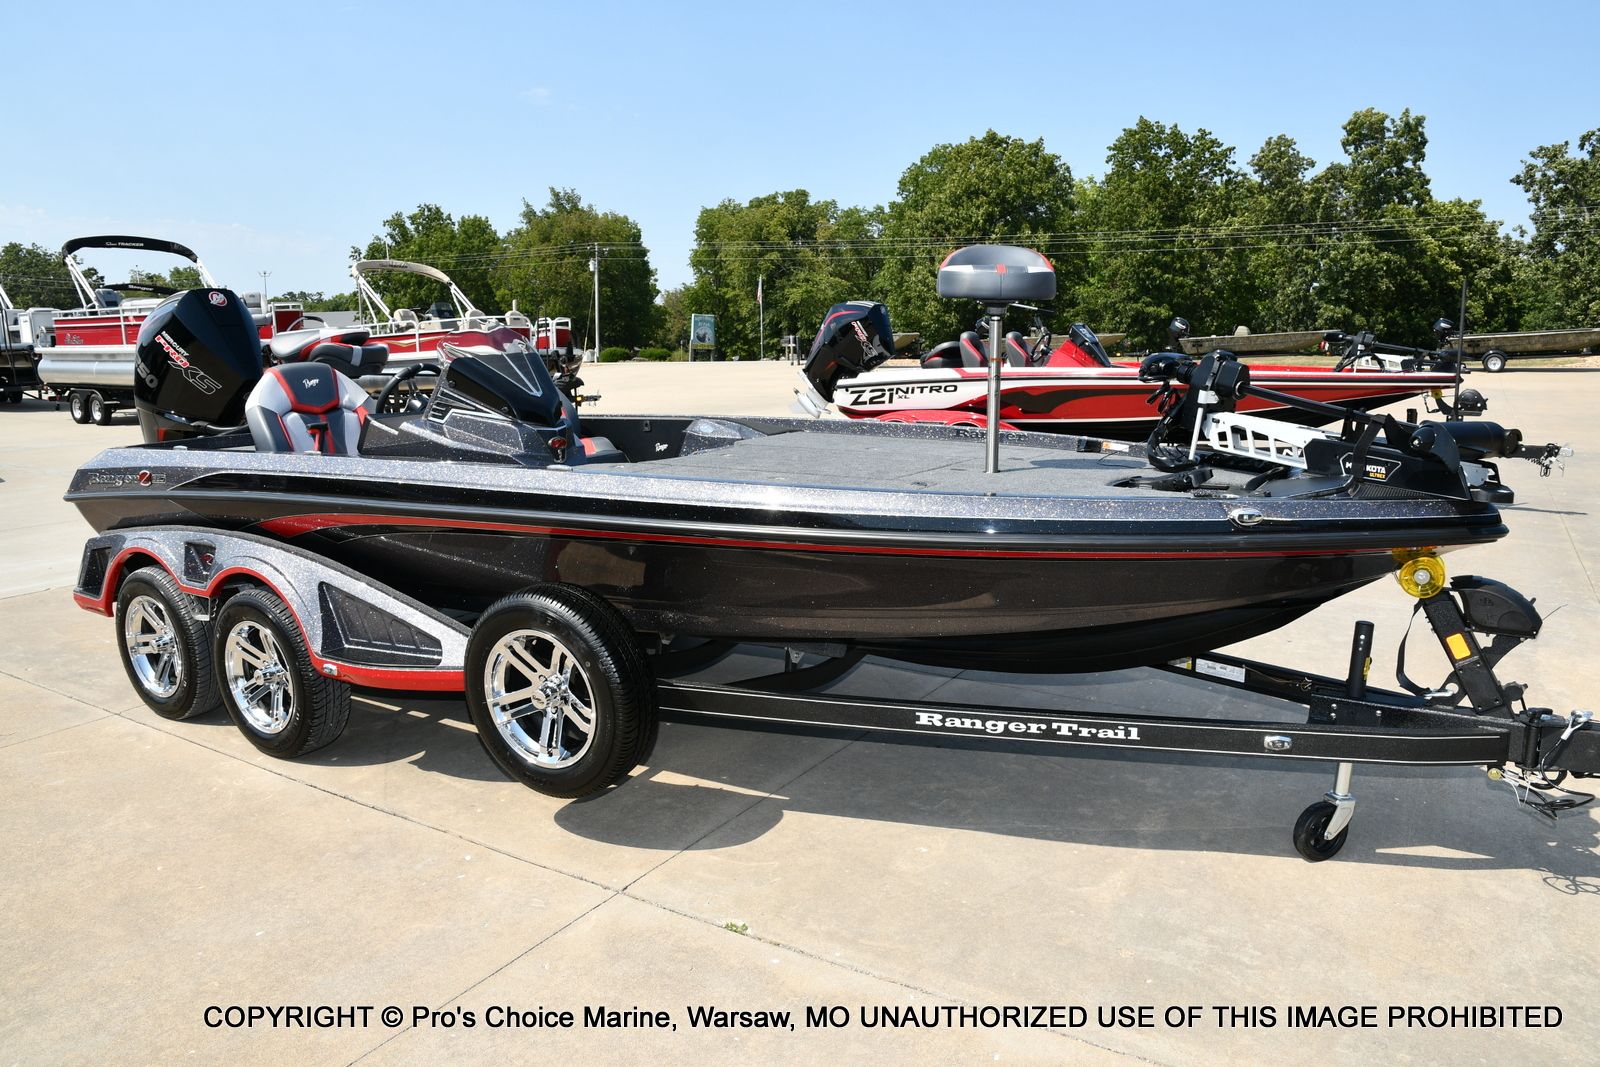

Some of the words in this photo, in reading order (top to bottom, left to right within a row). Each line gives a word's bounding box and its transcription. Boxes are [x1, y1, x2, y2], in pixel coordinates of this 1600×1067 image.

[155, 334, 190, 369] PRO
[161, 330, 190, 356] MERCURY
[168, 360, 222, 395] XS
[850, 388, 895, 406] Z21
[895, 384, 958, 395] NITRO
[88, 472, 140, 486] Ranger
[1365, 464, 1386, 474] KOTA
[915, 712, 1047, 734] Ranger
[1051, 722, 1141, 740] Trail
